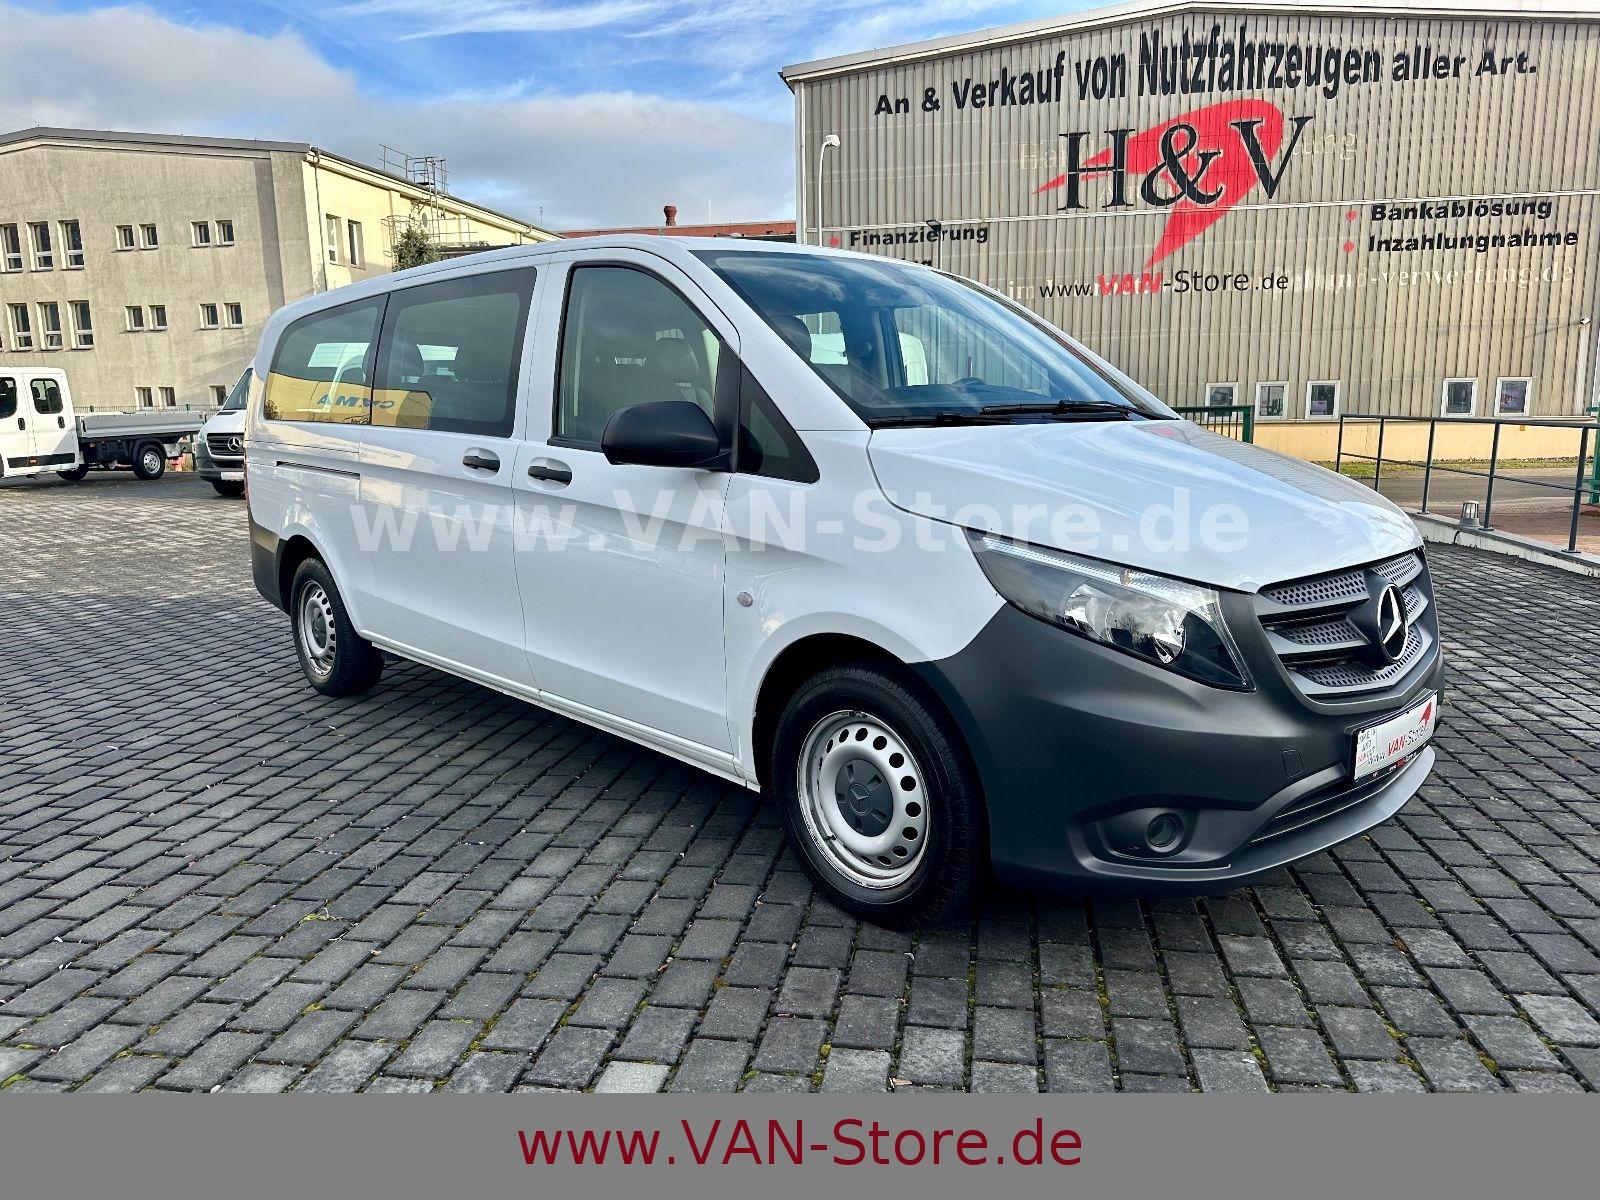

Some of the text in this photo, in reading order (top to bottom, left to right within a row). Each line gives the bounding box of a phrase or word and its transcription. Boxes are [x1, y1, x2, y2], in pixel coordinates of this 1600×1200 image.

[874, 22, 1538, 116] An & Verkauf von Nutzfahrzeugen aller Art.
[1370, 200, 1553, 222] Bankablösung
[850, 226, 989, 246] Finanzierung
[1368, 231, 1579, 254] Inzahlungnahme
